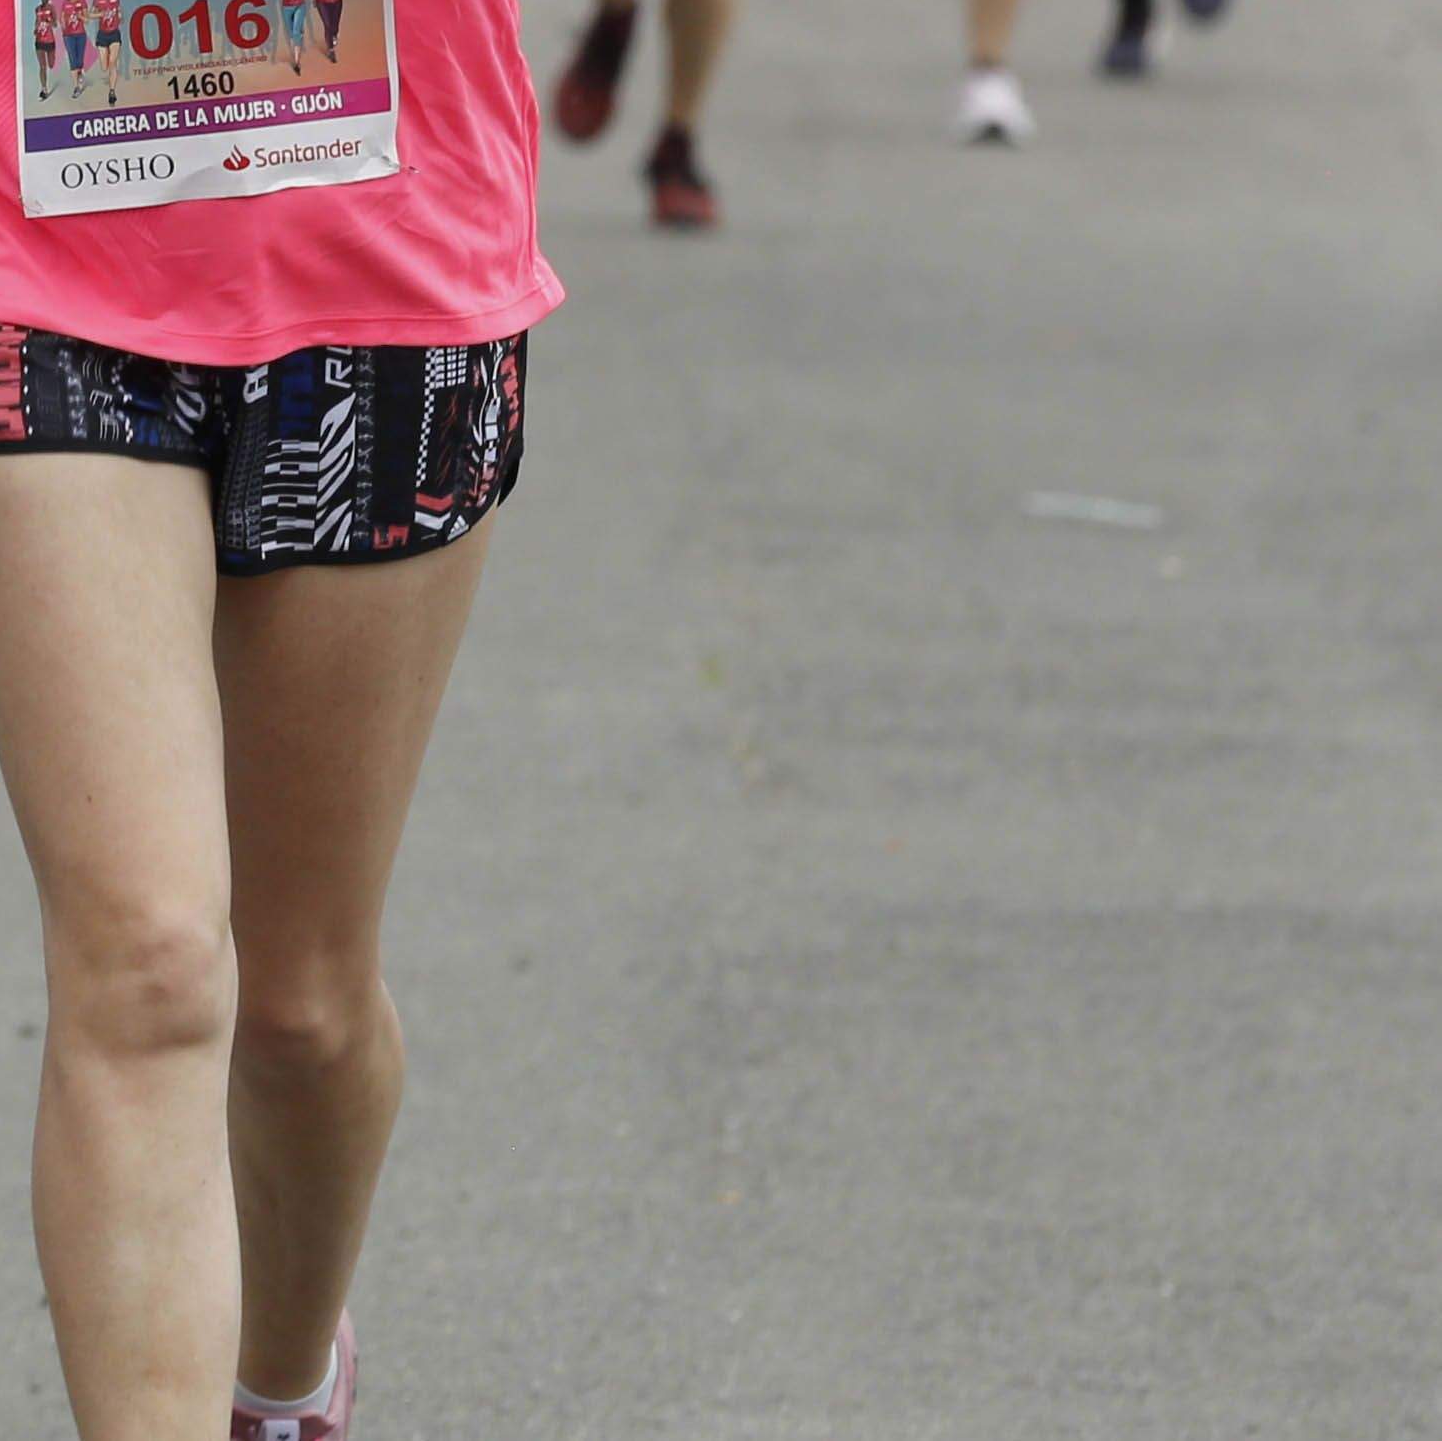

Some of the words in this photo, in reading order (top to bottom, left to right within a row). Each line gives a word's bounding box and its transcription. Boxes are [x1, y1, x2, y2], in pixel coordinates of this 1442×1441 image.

[168, 71, 235, 100] 1460
[72, 115, 151, 140] CARRERA
[156, 111, 181, 131] DE
[185, 108, 209, 128] LA
[214, 100, 277, 125] MUJER
[291, 88, 344, 115] GIJÓN
[61, 153, 175, 190] OYSHO
[254, 139, 364, 169] Santander
